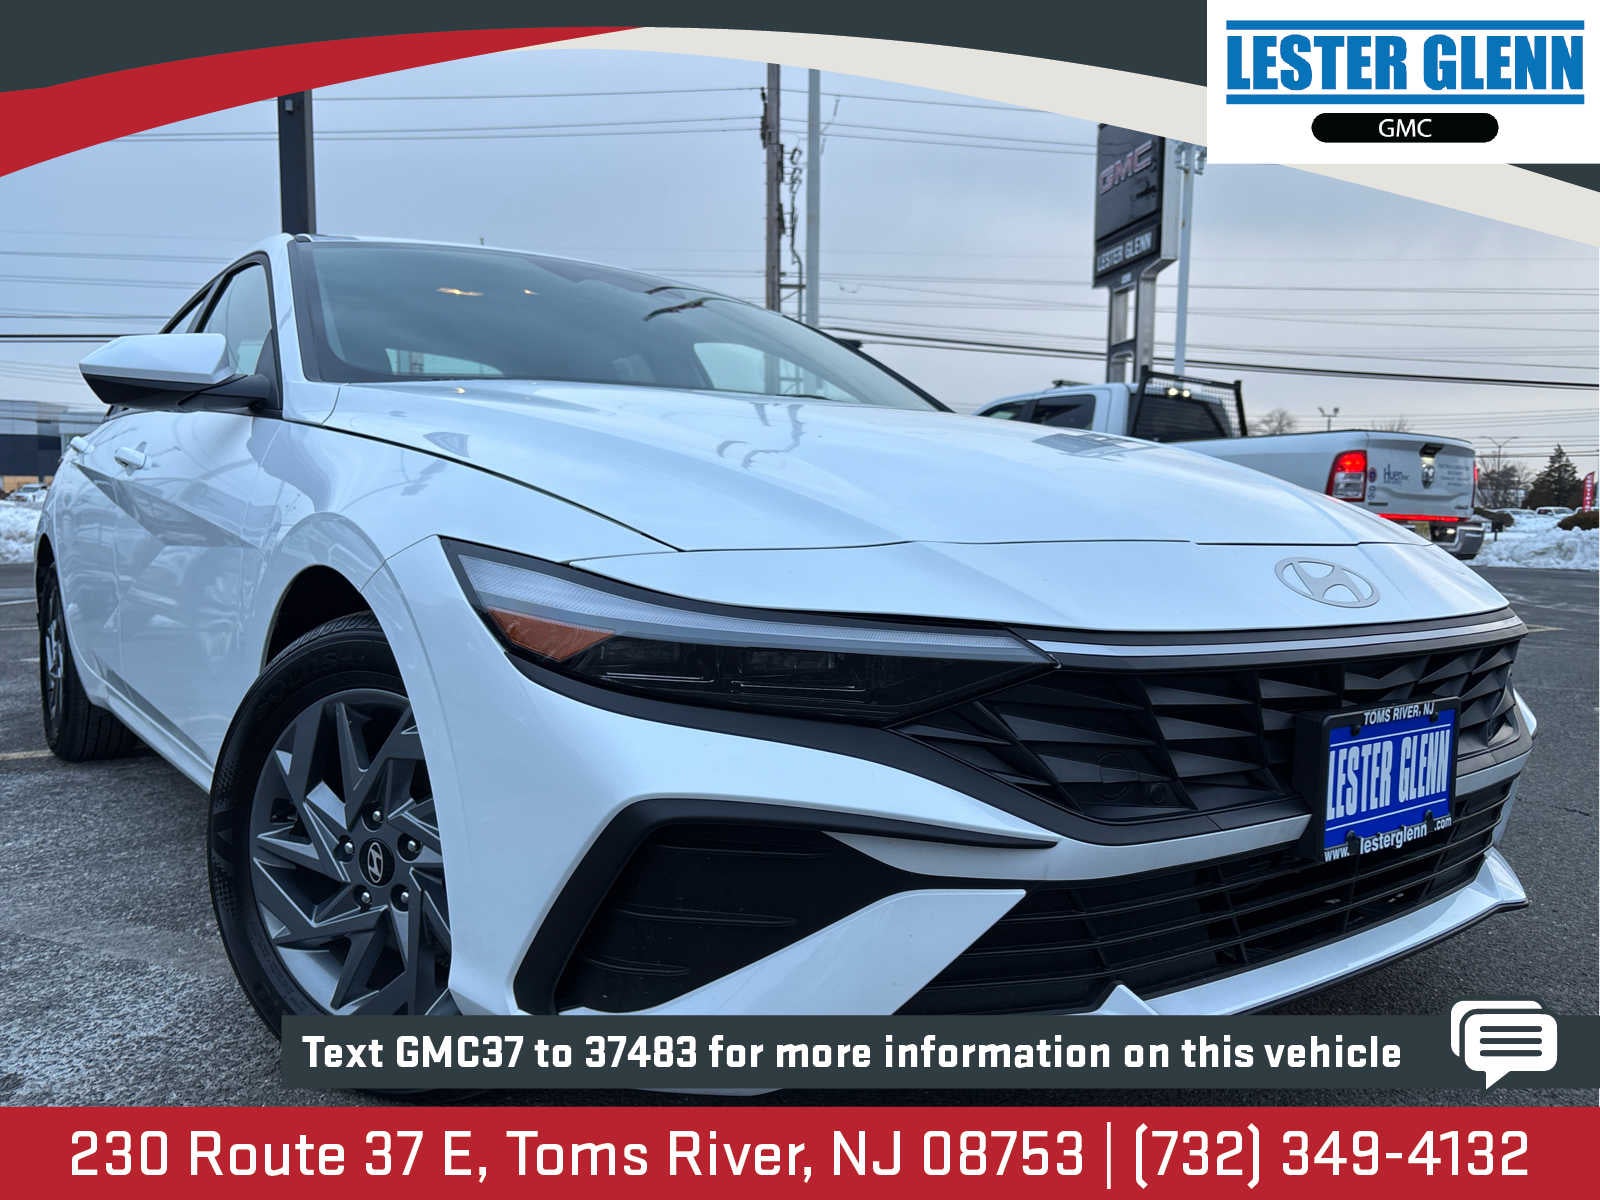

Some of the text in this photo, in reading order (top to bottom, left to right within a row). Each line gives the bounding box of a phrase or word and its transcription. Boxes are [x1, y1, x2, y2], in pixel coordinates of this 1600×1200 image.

[1099, 140, 1152, 195] GMC
[1097, 231, 1152, 271] LESTER GLENN
[1364, 702, 1435, 726] TOMS RIVER, NJ
[1326, 729, 1451, 821] LESTER GLENN
[1359, 823, 1428, 855] lesterglenn
